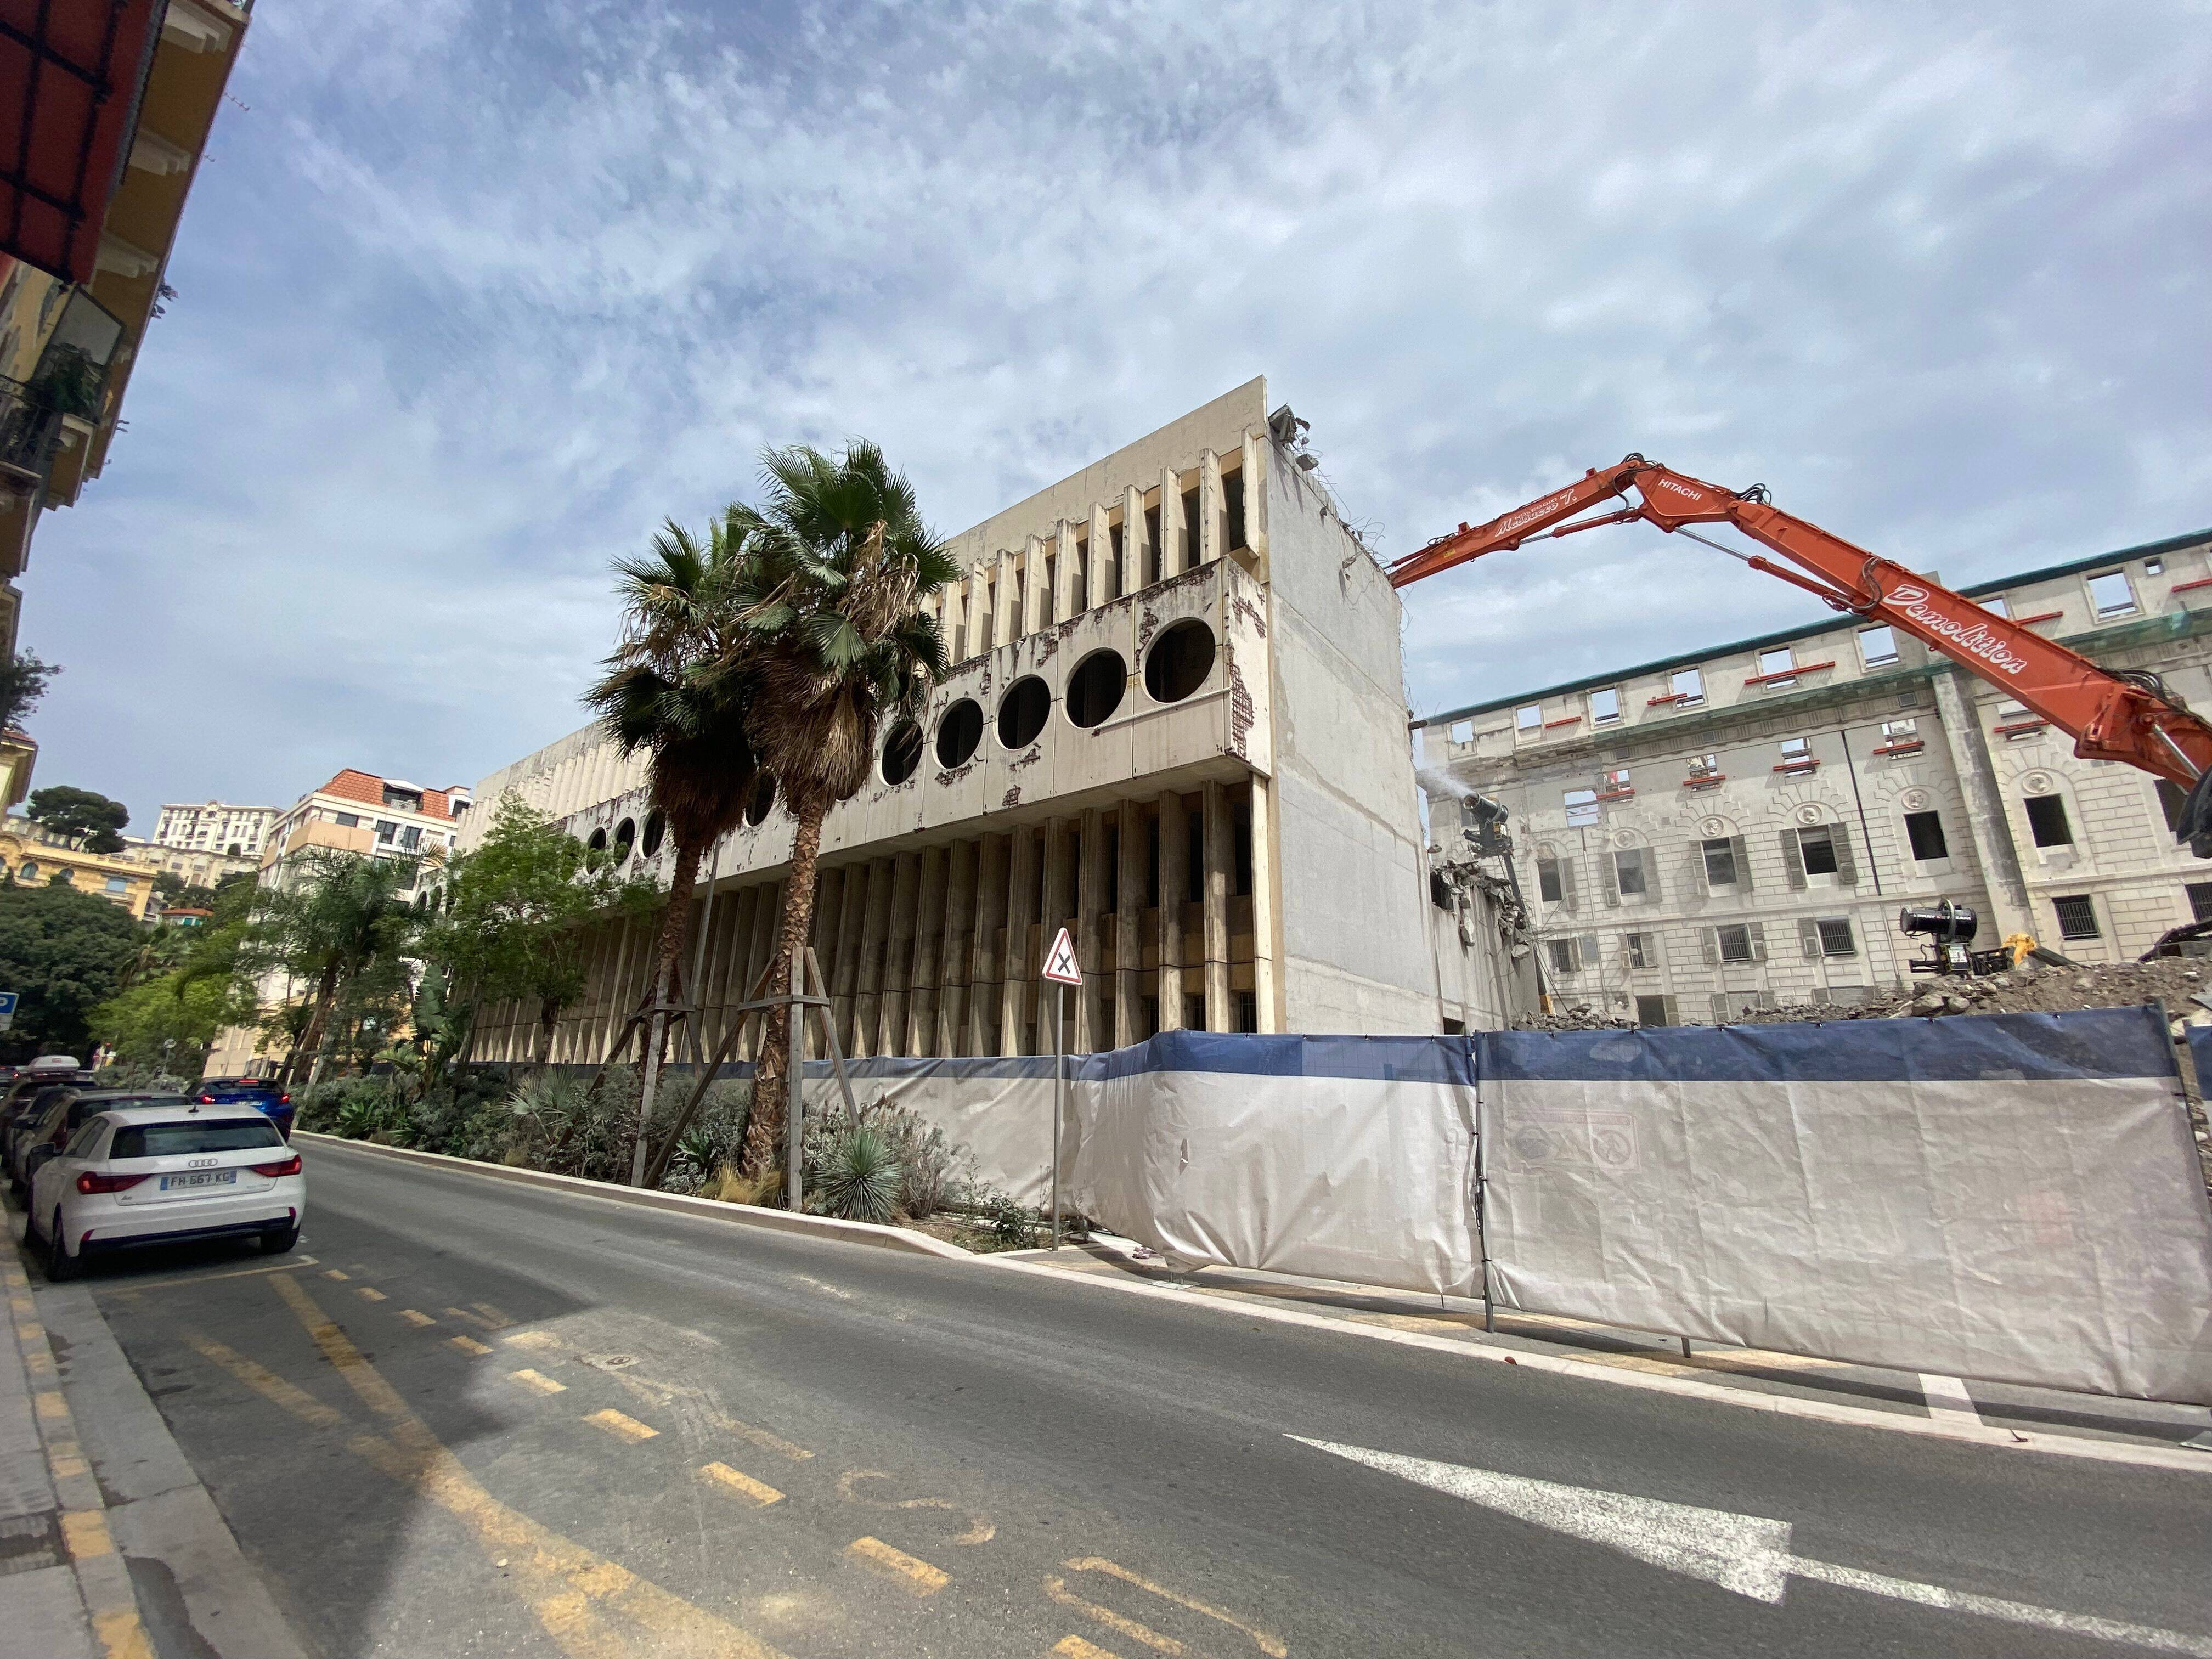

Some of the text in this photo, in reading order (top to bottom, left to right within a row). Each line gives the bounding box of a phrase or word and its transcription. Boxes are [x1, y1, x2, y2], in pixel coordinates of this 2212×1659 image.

[1559, 488, 1577, 505] T.
[1658, 478, 1702, 501] HITACHI
[1514, 498, 1558, 520] NOLEGGIO
[1882, 584, 2028, 675] Demolition
